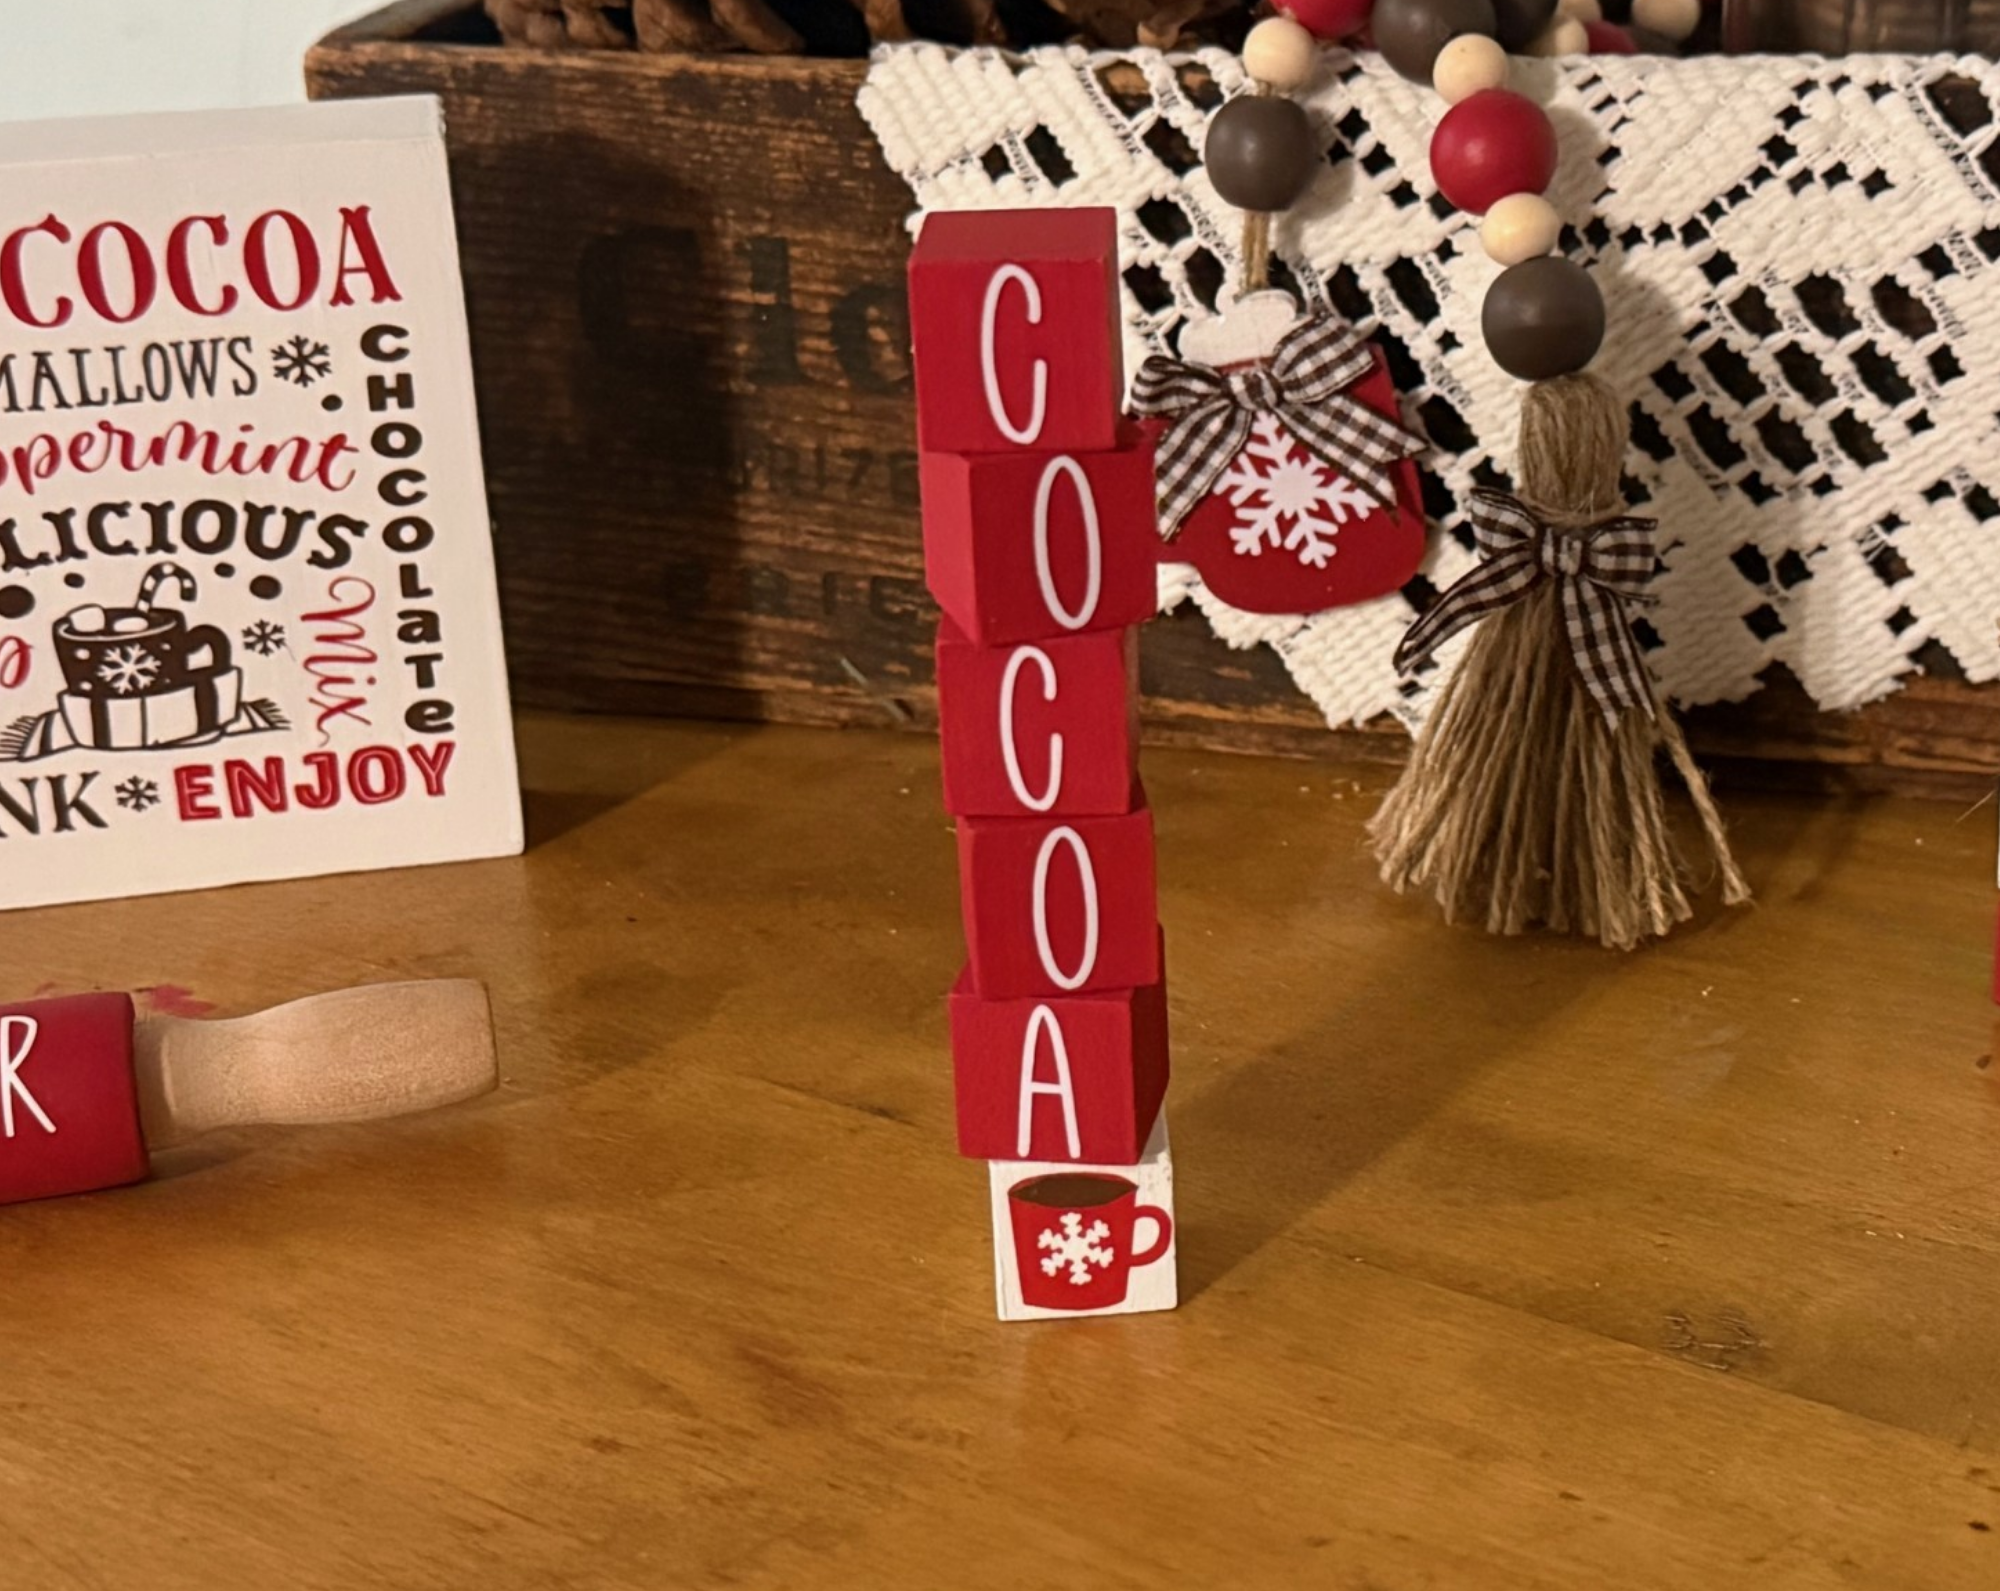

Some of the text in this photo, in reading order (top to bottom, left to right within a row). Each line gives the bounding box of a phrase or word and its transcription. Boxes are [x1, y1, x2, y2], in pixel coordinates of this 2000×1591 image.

[0, 205, 403, 328] COCOA
[0, 420, 360, 496] permint
[981, 263, 1100, 1158] COCOA
[174, 741, 456, 821] ENJOY
